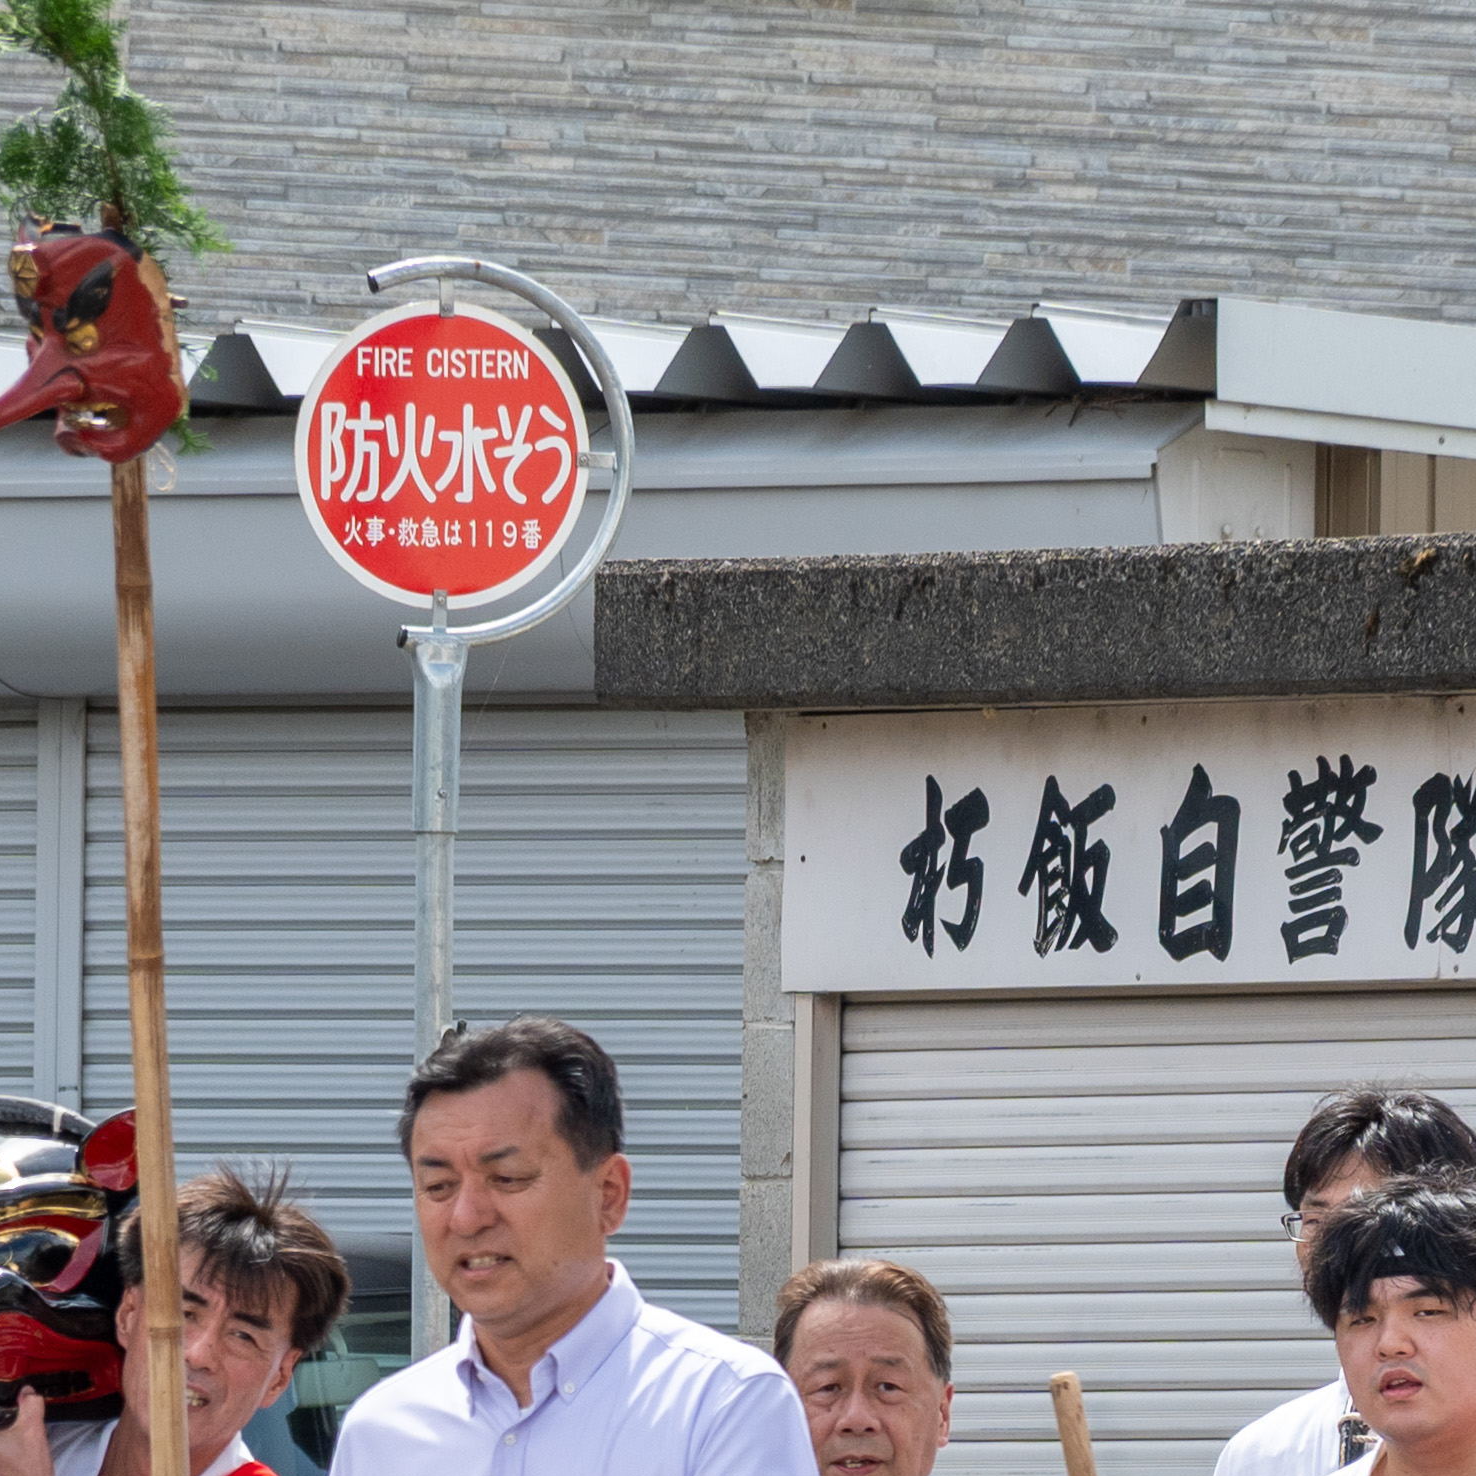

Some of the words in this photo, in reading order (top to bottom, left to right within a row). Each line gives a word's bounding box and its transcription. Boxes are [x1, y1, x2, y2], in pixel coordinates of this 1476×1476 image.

[357, 346, 413, 377] FIRE
[426, 348, 529, 380] CISTERN
[320, 401, 572, 504] 防火水そう
